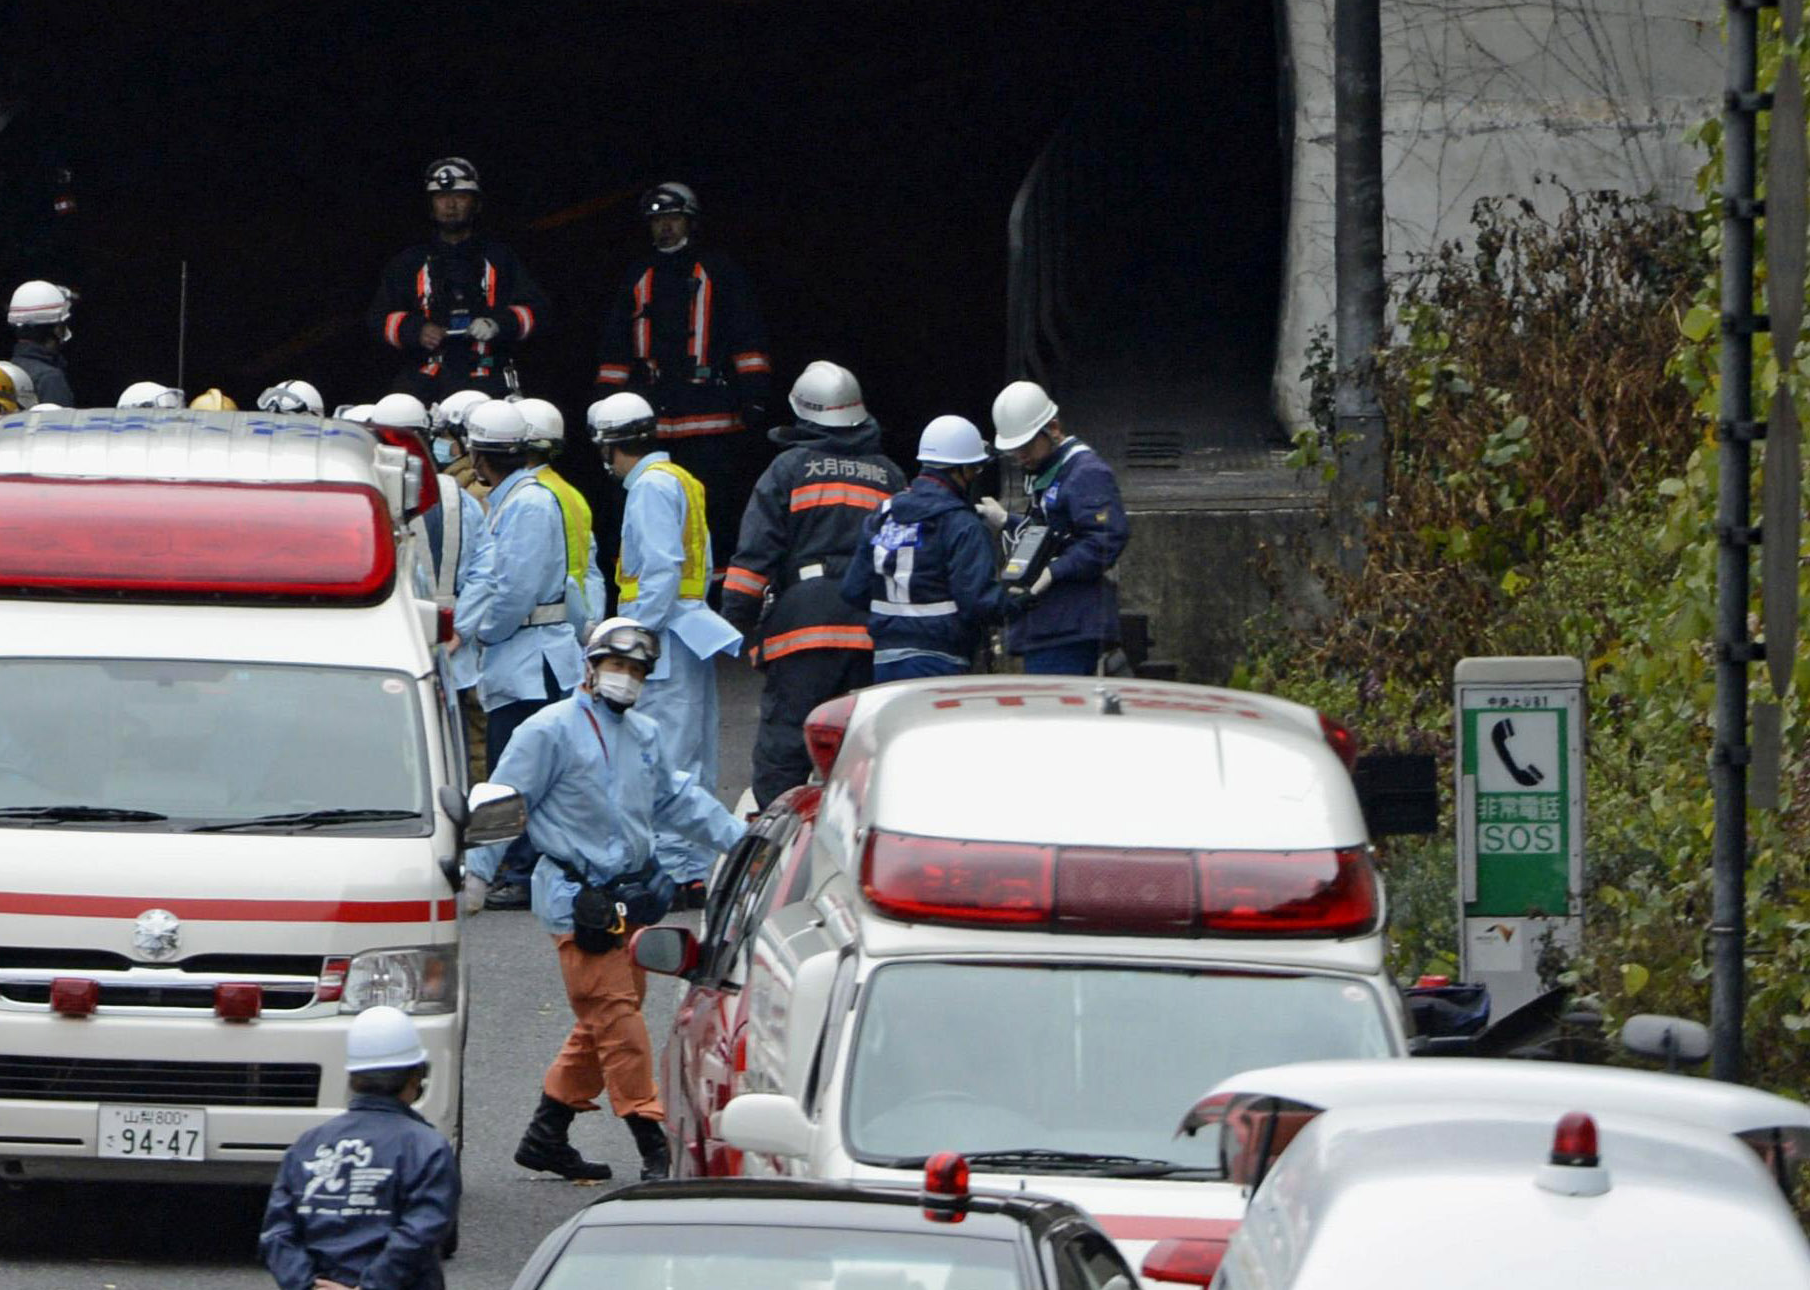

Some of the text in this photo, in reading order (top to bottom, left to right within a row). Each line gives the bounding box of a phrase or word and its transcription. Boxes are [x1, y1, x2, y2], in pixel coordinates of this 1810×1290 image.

[804, 457, 888, 485] 大月市消防
[1478, 796, 1560, 820] 非常電話
[1485, 825, 1554, 852] SOS
[122, 1128, 199, 1156] 94-47
